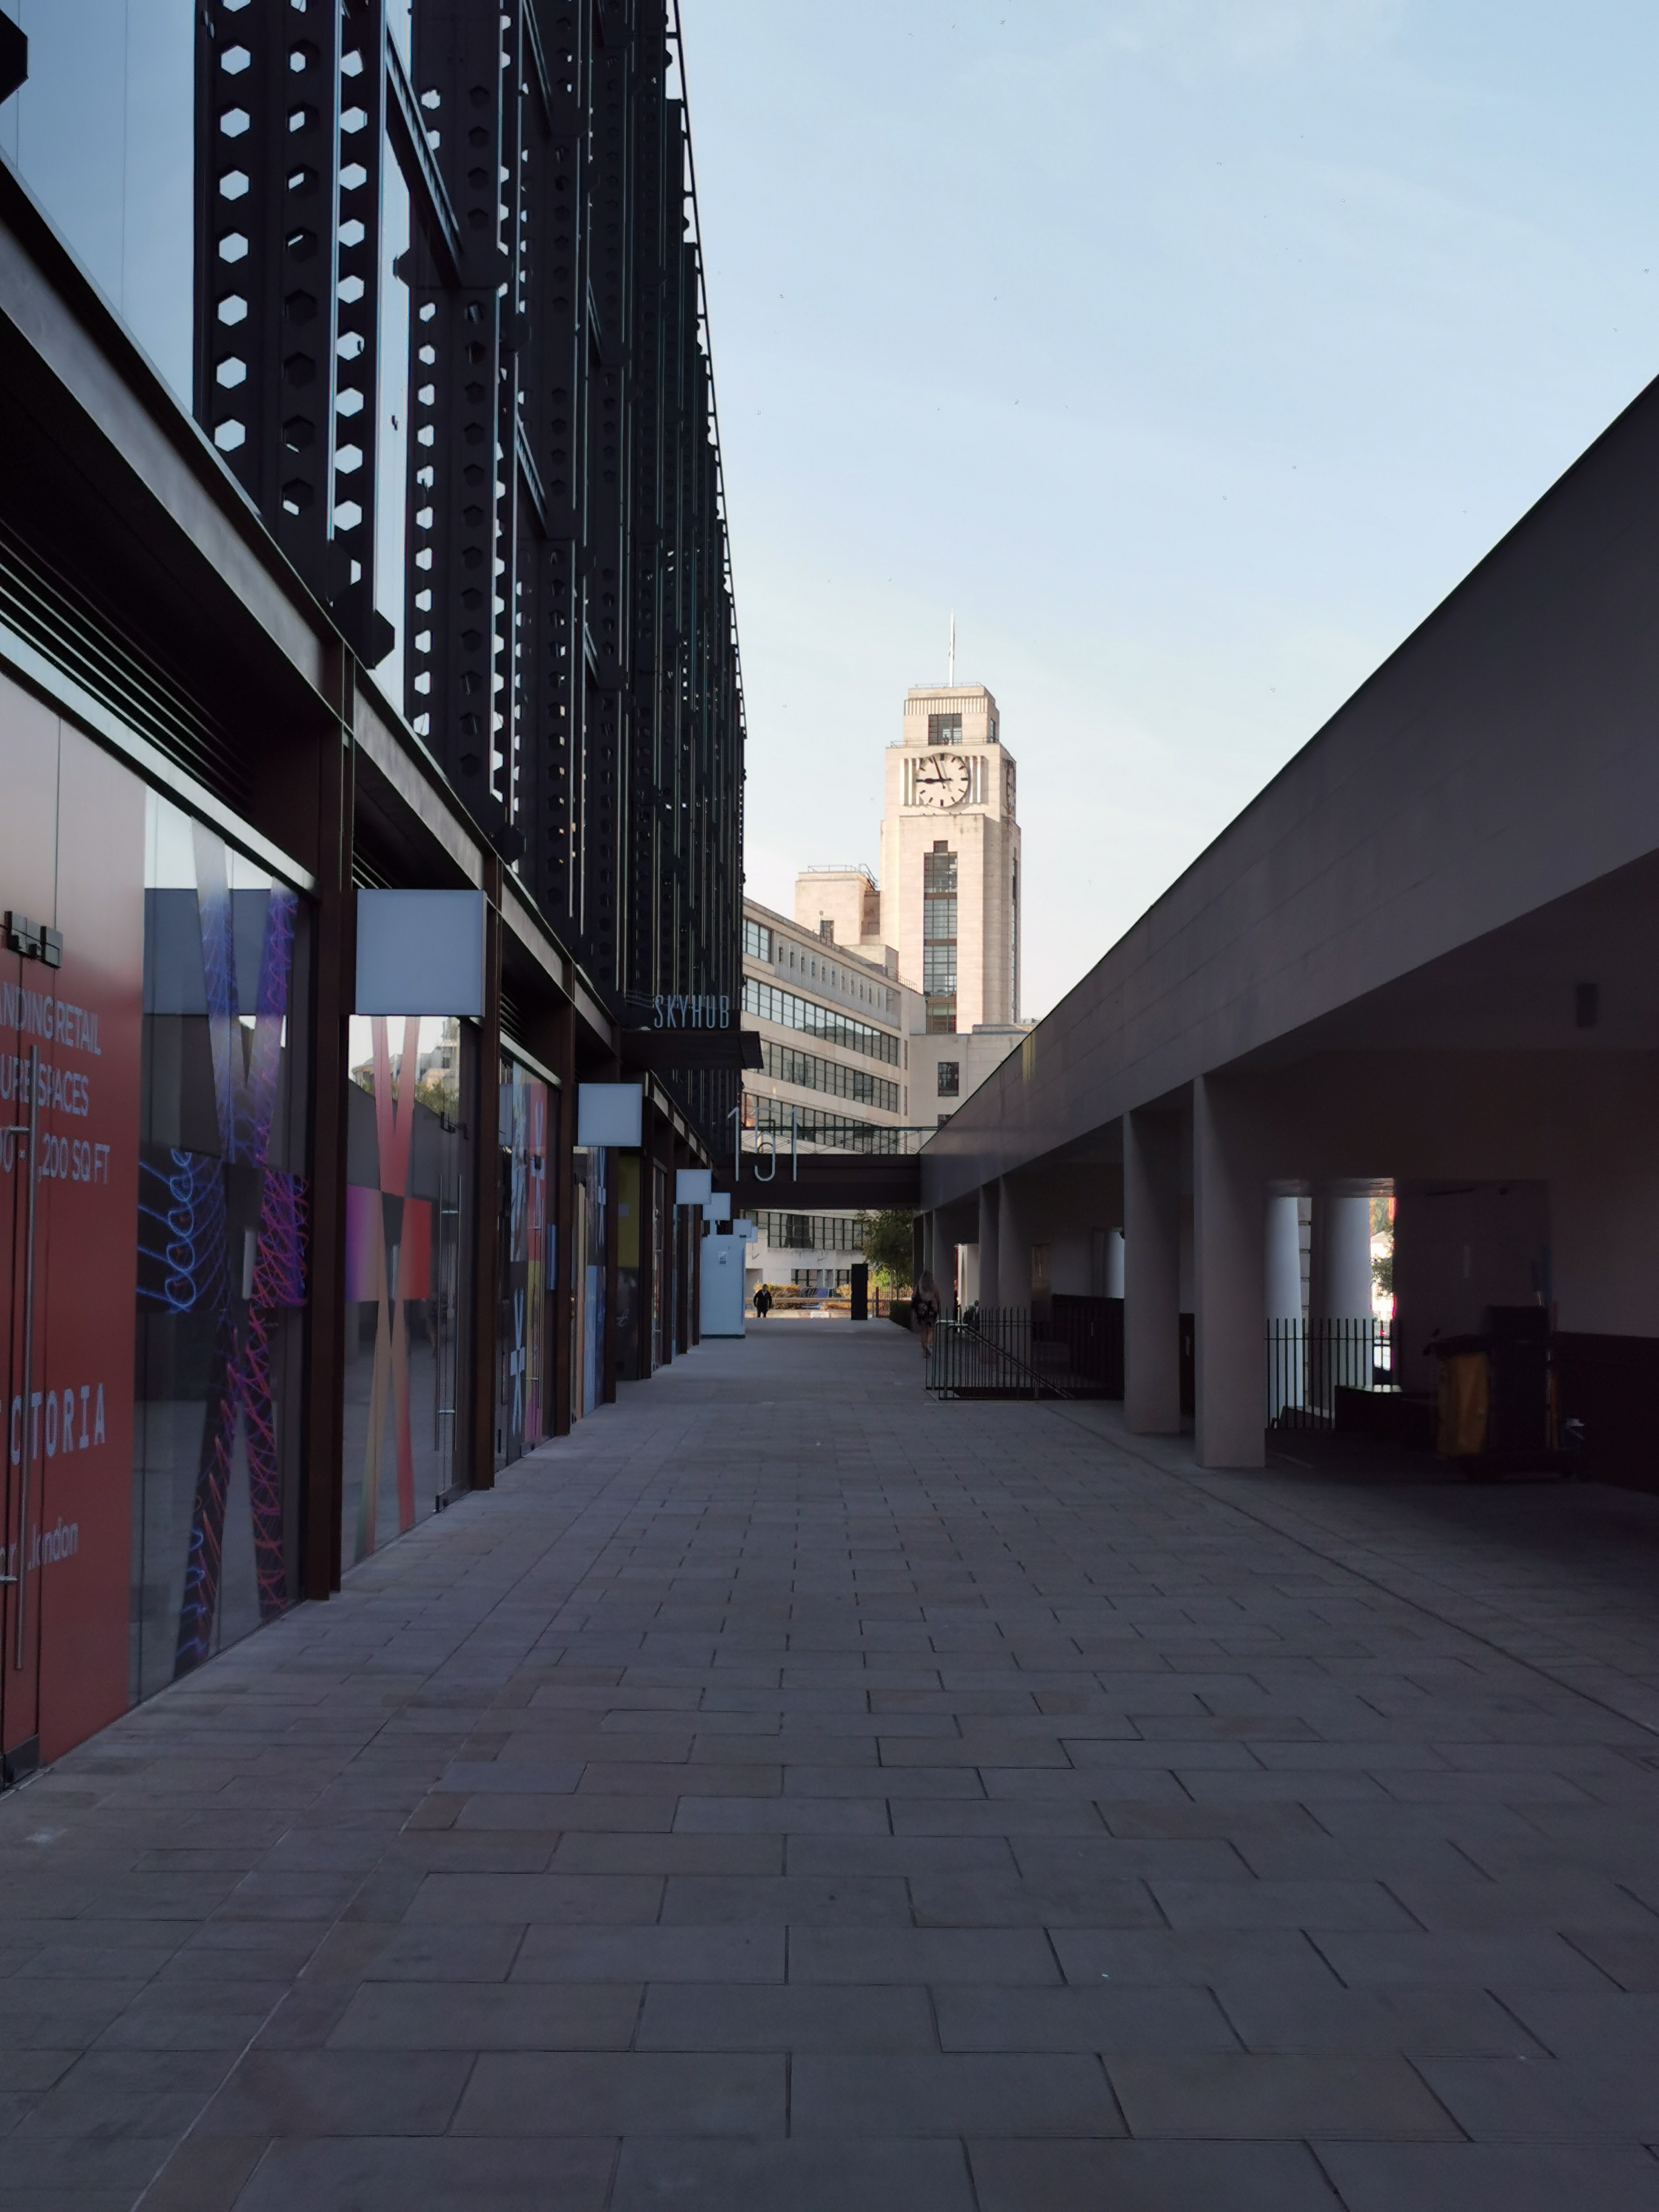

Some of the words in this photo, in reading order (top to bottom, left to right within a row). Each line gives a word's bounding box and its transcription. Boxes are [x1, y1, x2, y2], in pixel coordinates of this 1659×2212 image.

[0, 981, 53, 1039] NDING
[55, 1000, 101, 1055] RETAIL
[654, 994, 730, 1029] SKYHUB
[0, 1053, 30, 1104] URE
[38, 1062, 89, 1117] SPACES
[72, 1139, 91, 1182] SQ
[95, 1143, 110, 1184] FT
[726, 1106, 797, 1182] 151
[0, 1382, 106, 1466] CTORIA
